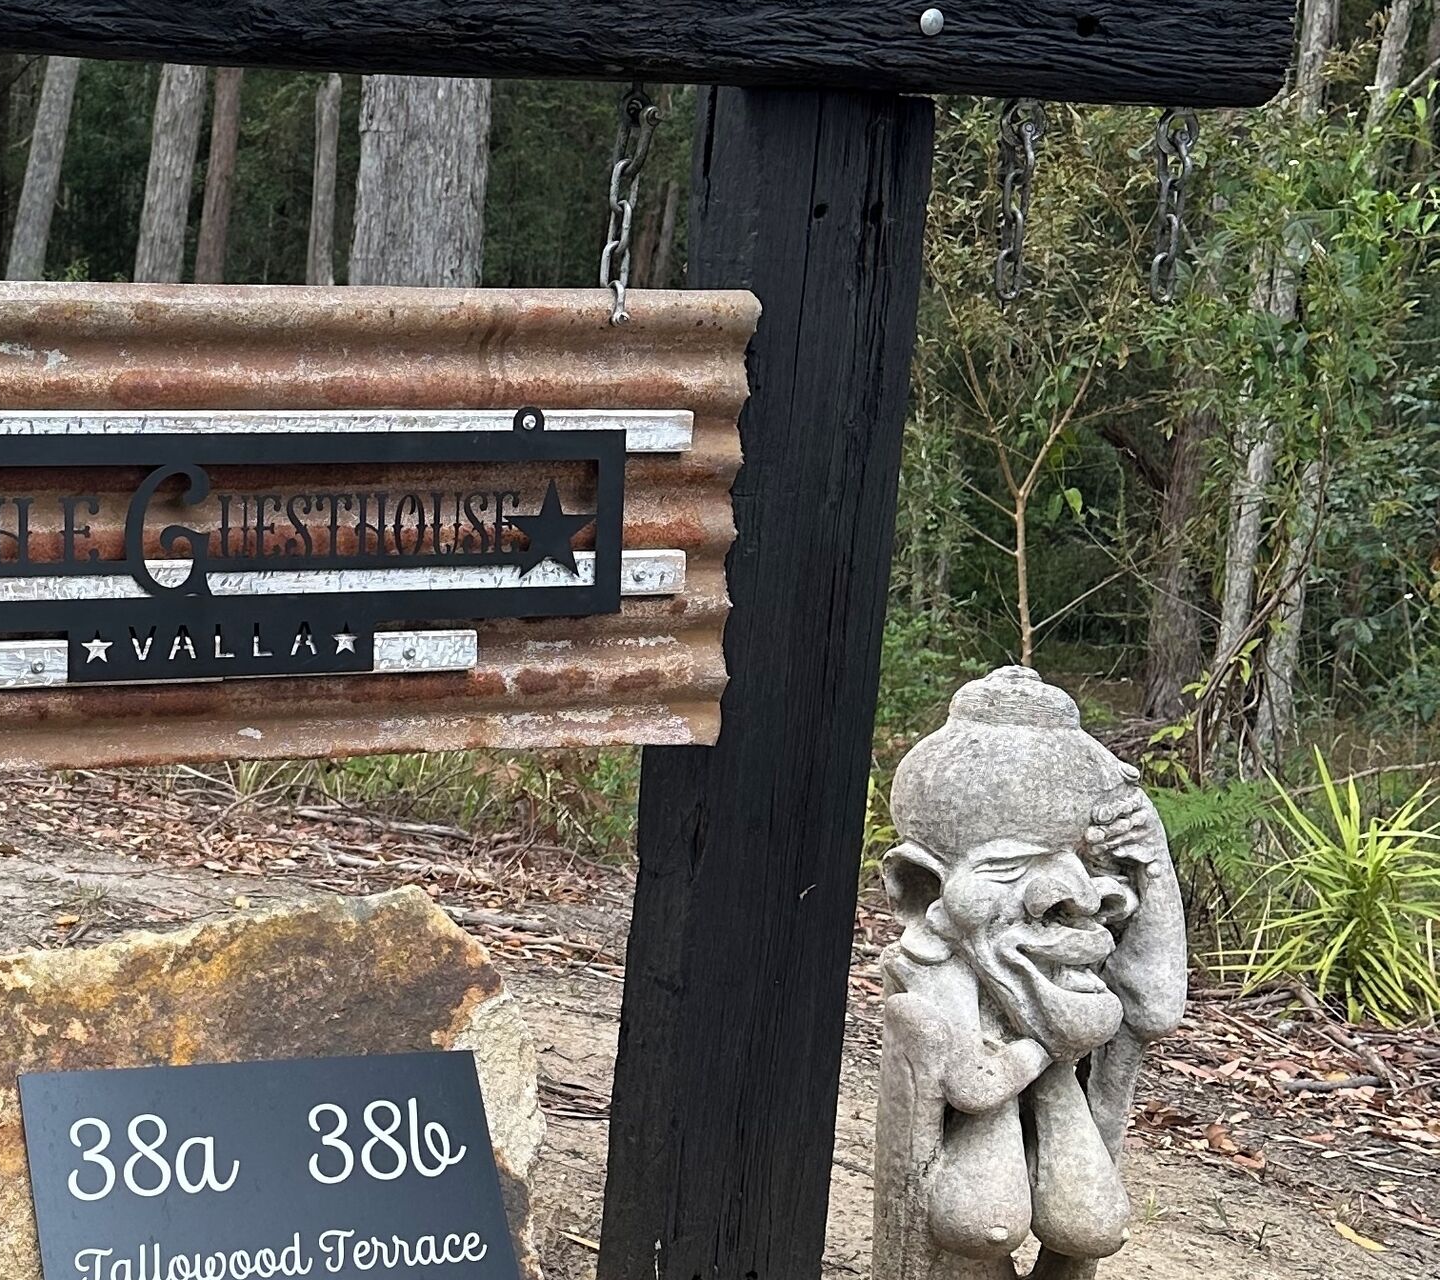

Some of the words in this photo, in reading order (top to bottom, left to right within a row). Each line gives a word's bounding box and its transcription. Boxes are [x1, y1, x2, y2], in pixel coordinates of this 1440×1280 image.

[128, 621, 318, 661] VALLA
[67, 1113, 240, 1201] 38a
[307, 1097, 467, 1185] 38b
[318, 1228, 488, 1273] Terrace
